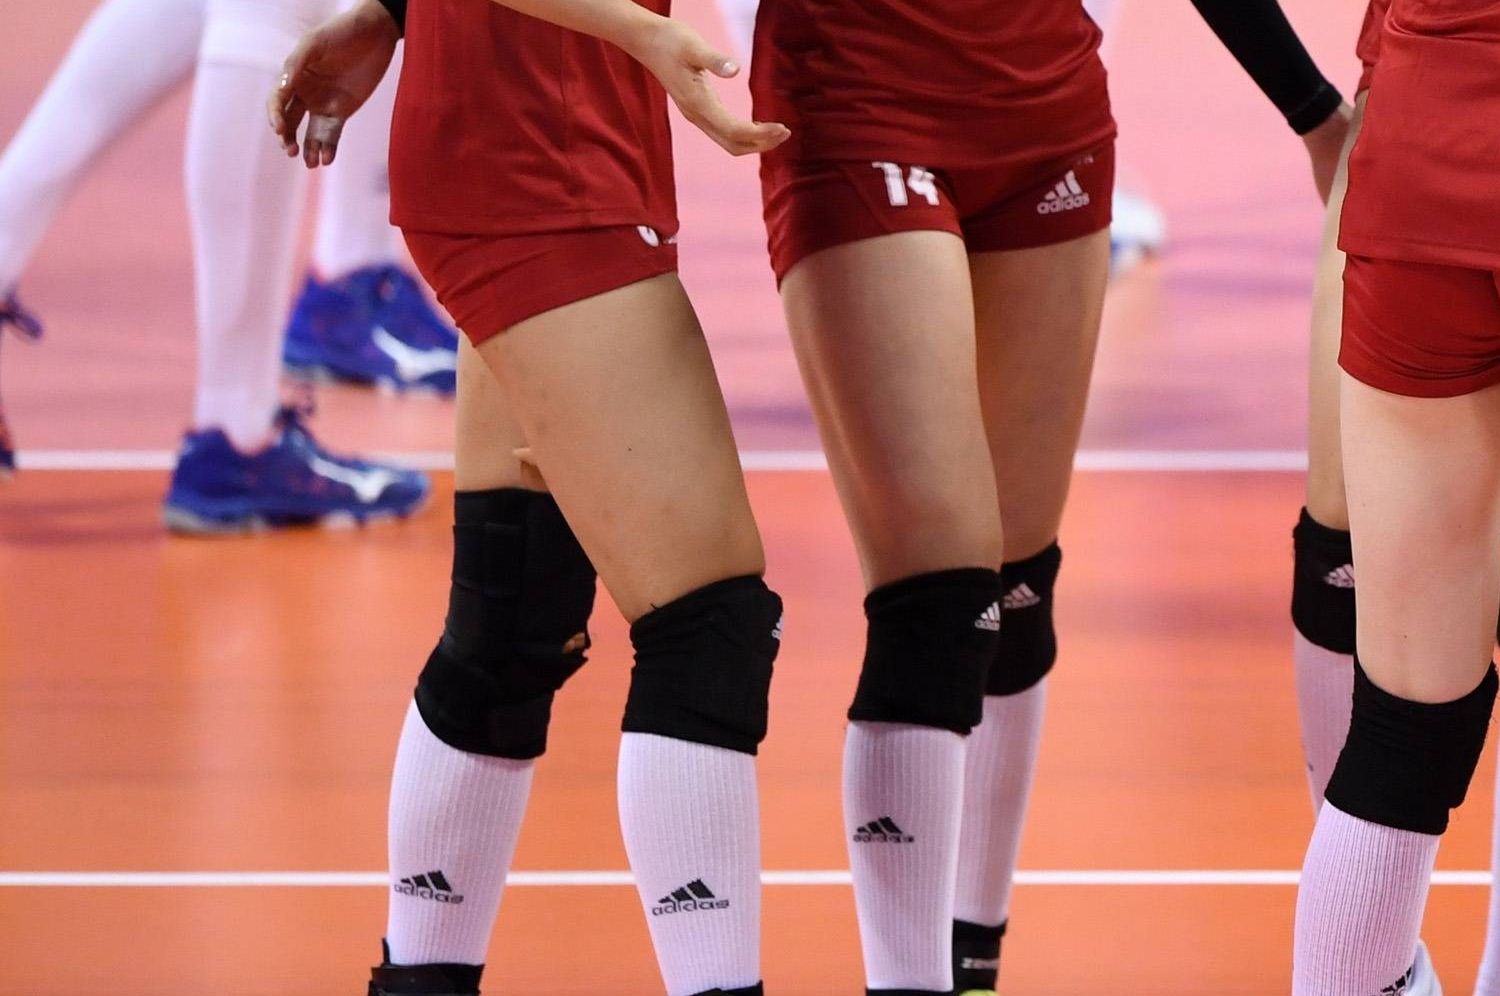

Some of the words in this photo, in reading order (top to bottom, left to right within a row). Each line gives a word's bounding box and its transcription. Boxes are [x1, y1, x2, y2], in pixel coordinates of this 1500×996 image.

[872, 161, 940, 206] 14
[1037, 191, 1089, 215] adidas
[652, 898, 730, 916] adidas
